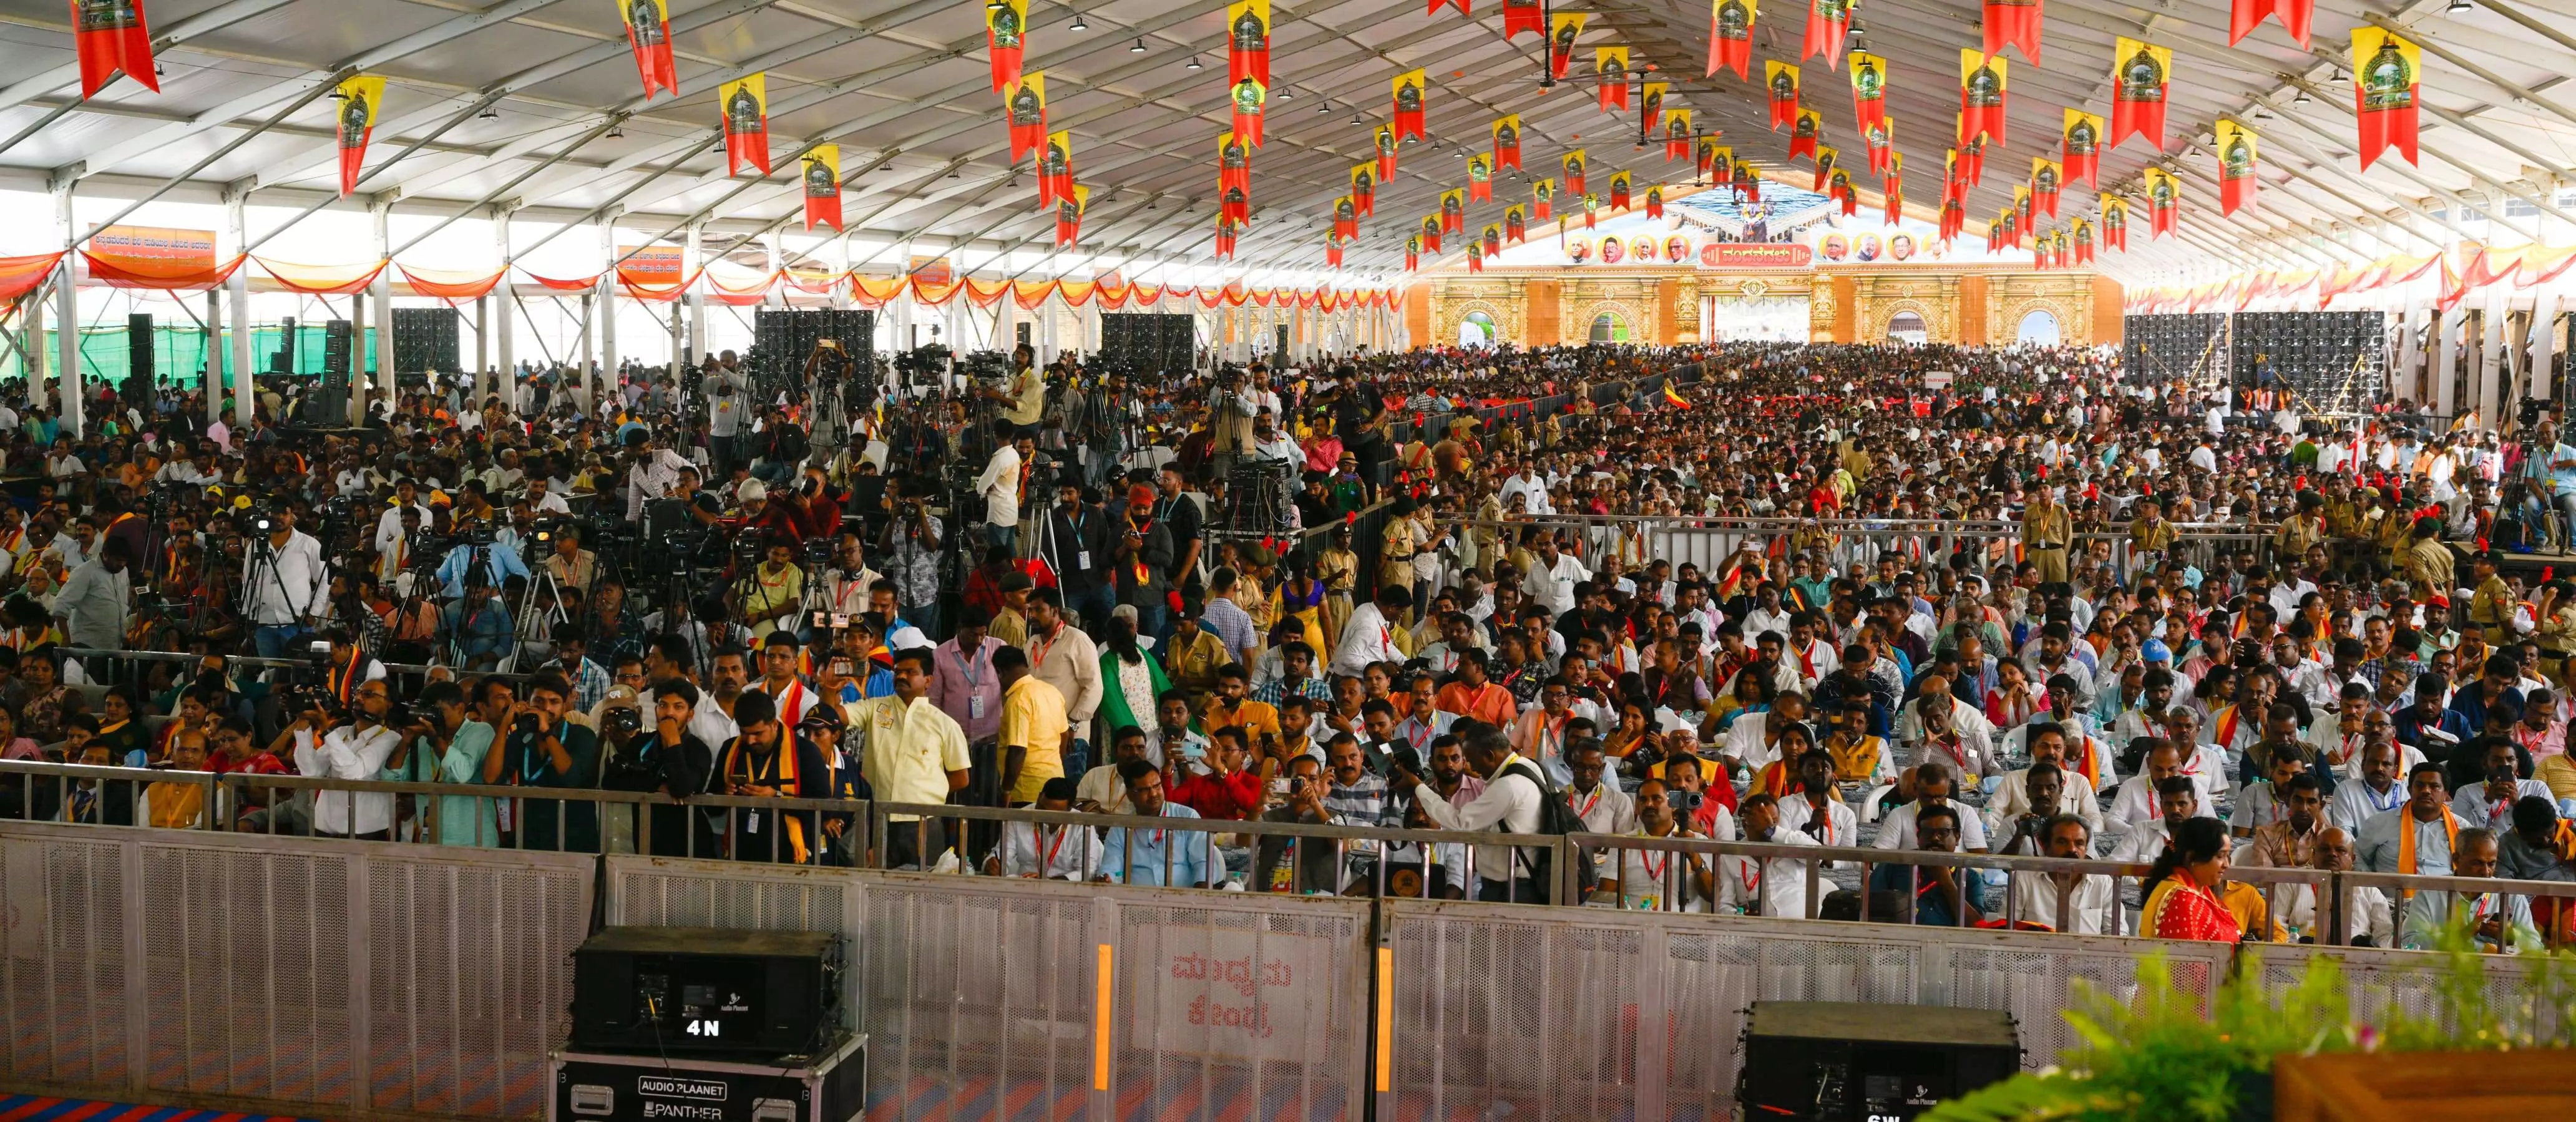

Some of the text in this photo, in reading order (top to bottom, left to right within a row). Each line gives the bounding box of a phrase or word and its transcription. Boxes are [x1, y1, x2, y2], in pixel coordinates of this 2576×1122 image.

[1722, 246, 1792, 263] ವಂದನೆಗಳು
[1171, 951, 1291, 997] ಮಾಧ್ಯಮ
[1188, 995, 1273, 1039] ಕೇಂದ್ರ
[642, 1081, 724, 1096] AUDIO PLAANET
[655, 1103, 722, 1121] PANTHER
